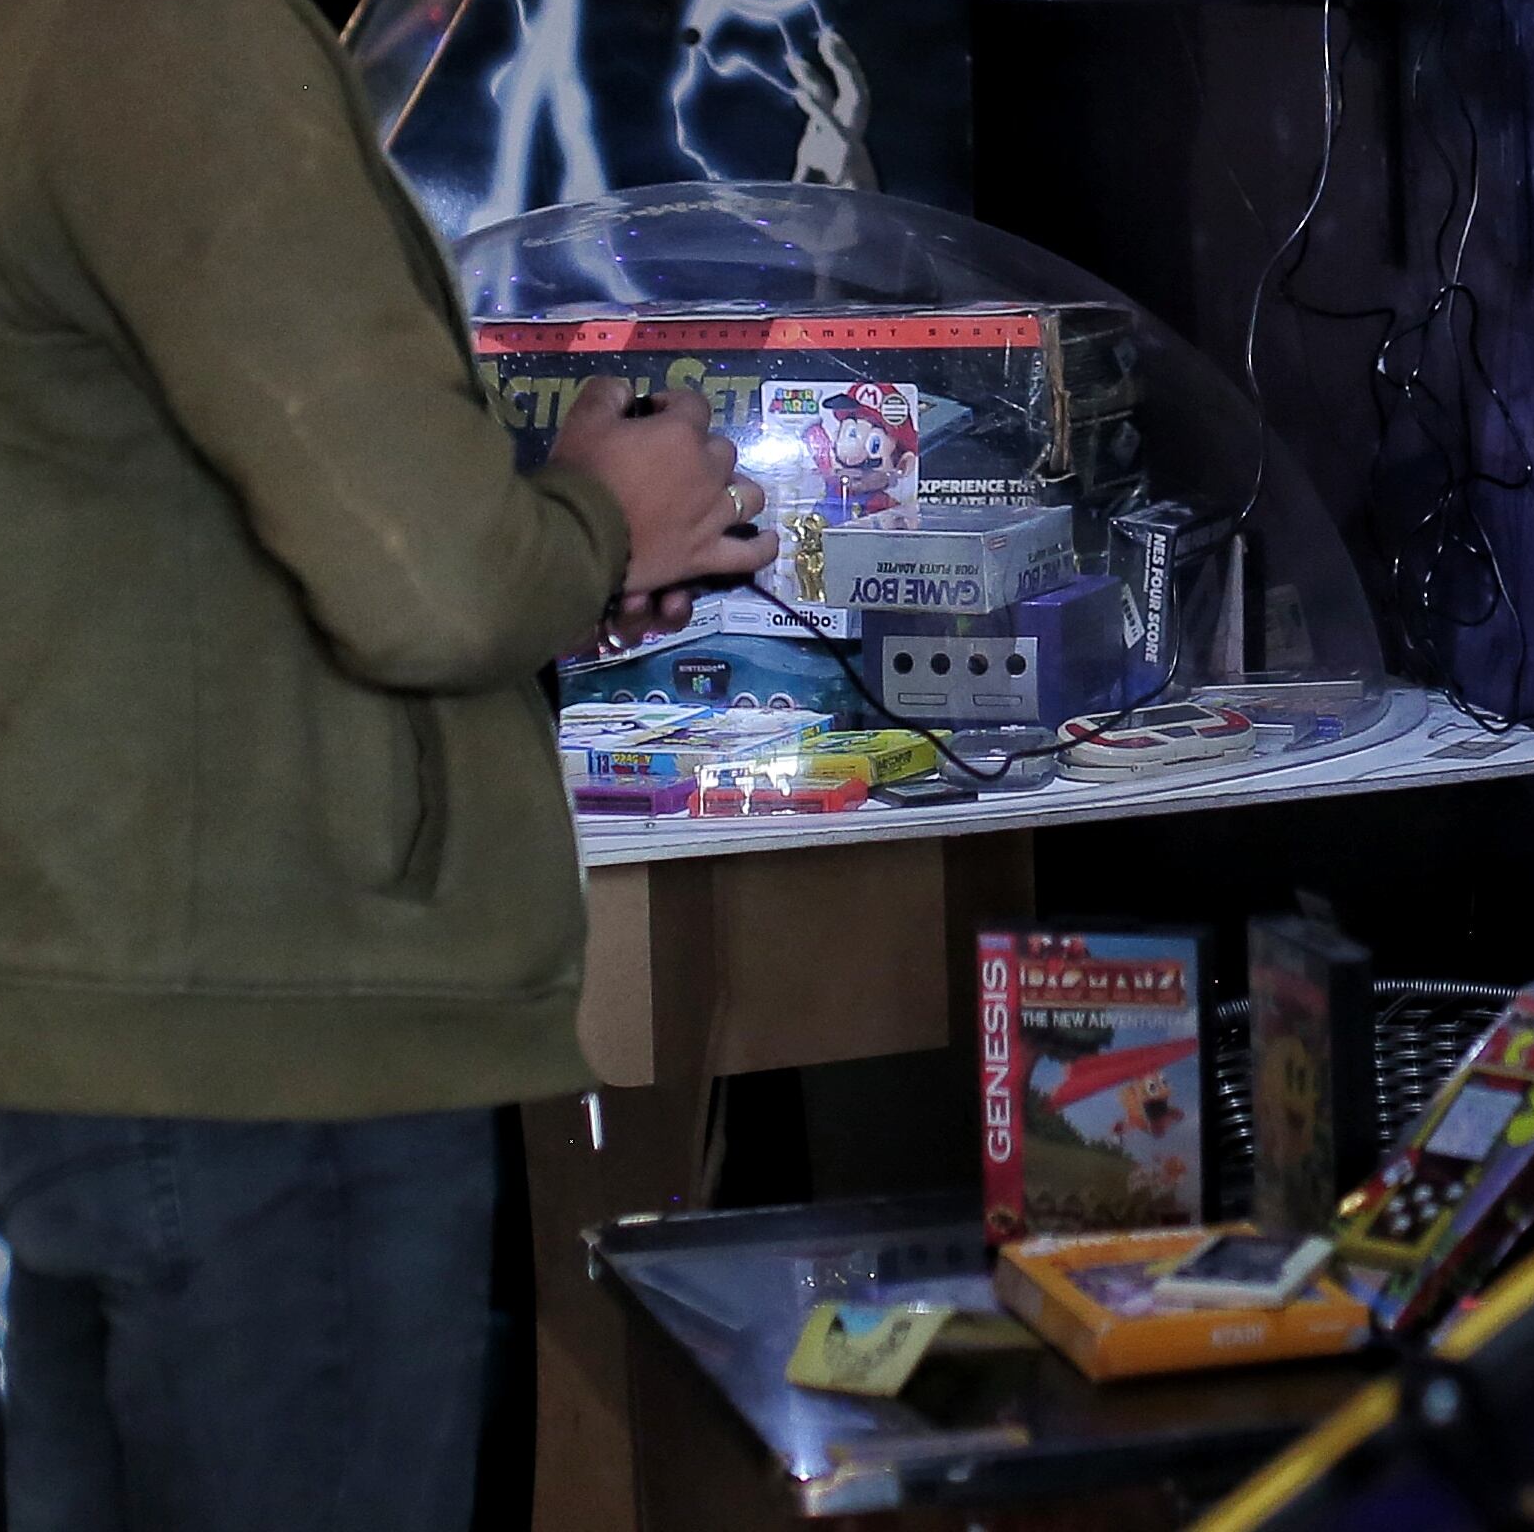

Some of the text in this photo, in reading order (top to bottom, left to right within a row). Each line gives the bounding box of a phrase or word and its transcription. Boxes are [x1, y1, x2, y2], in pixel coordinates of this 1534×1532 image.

[768, 398, 818, 415] MARIO
[918, 478, 1006, 494] XPERIENCE
[849, 576, 981, 607] GAME BOY
[1144, 532, 1167, 664] NES FOUR SCORE
[1021, 1011, 1049, 1028] THE
[1053, 1011, 1086, 1029] NEW
[982, 957, 1013, 1165] GENESIS
